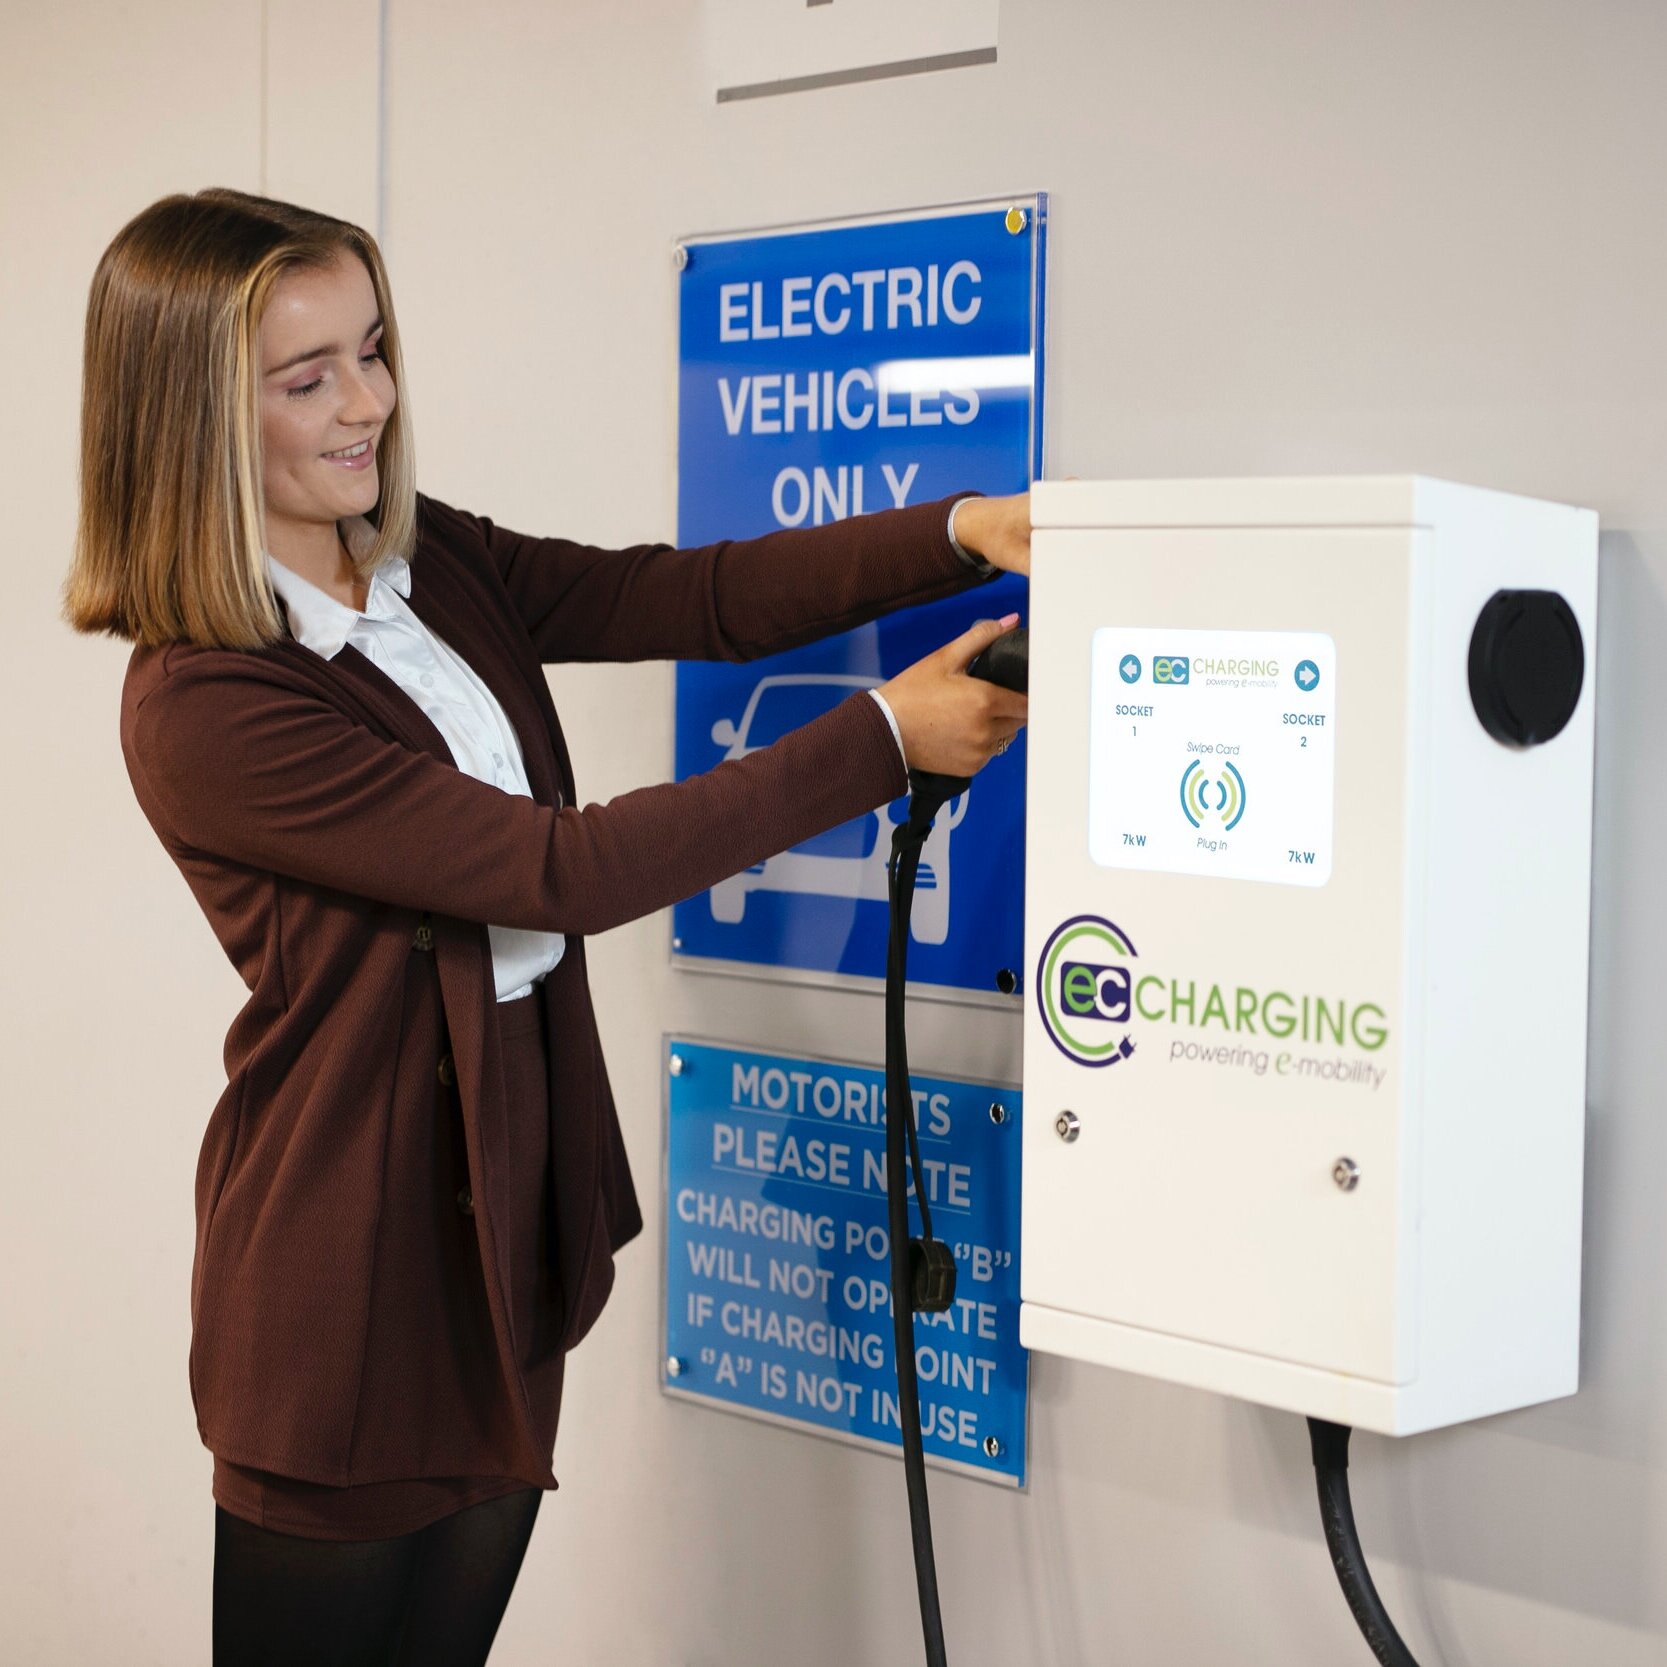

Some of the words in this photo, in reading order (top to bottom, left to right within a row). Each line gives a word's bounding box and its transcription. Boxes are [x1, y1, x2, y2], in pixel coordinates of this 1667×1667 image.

[719, 260, 981, 342] ELECTRIC
[717, 366, 980, 435] VEHICLES
[771, 463, 919, 527] ONLY
[1193, 658, 1279, 676] CHARGING
[1206, 678, 1239, 688] powering
[1115, 704, 1153, 716] SOCKET
[1132, 726, 1137, 736] 1
[1282, 713, 1325, 726] SOCKET
[1186, 741, 1213, 754] Swipe
[1216, 743, 1240, 755] Card
[1300, 736, 1307, 747] 2
[1122, 833, 1146, 847] 7kW
[1196, 837, 1217, 851] Plug
[1219, 841, 1228, 850] In
[1287, 850, 1315, 864] 7kW
[1135, 975, 1388, 1051] CHARGING
[1169, 1039, 1269, 1075] powering
[1275, 1049, 1386, 1091] e-mobility
[732, 1062, 951, 1136] MOTORITS
[712, 1122, 850, 1186] PLEASE
[676, 1187, 835, 1251] CHARGING
[686, 1241, 760, 1289] WILL
[769, 1258, 834, 1302] NOT
[843, 1275, 997, 1340] OPATE
[687, 1292, 713, 1327] IF
[720, 1302, 884, 1369] CHARGING
[894, 1345, 996, 1395] OINT
[760, 1361, 787, 1399] IS
[796, 1370, 862, 1418] NOT
[872, 1388, 901, 1429] IN
[918, 1400, 977, 1448] USE
